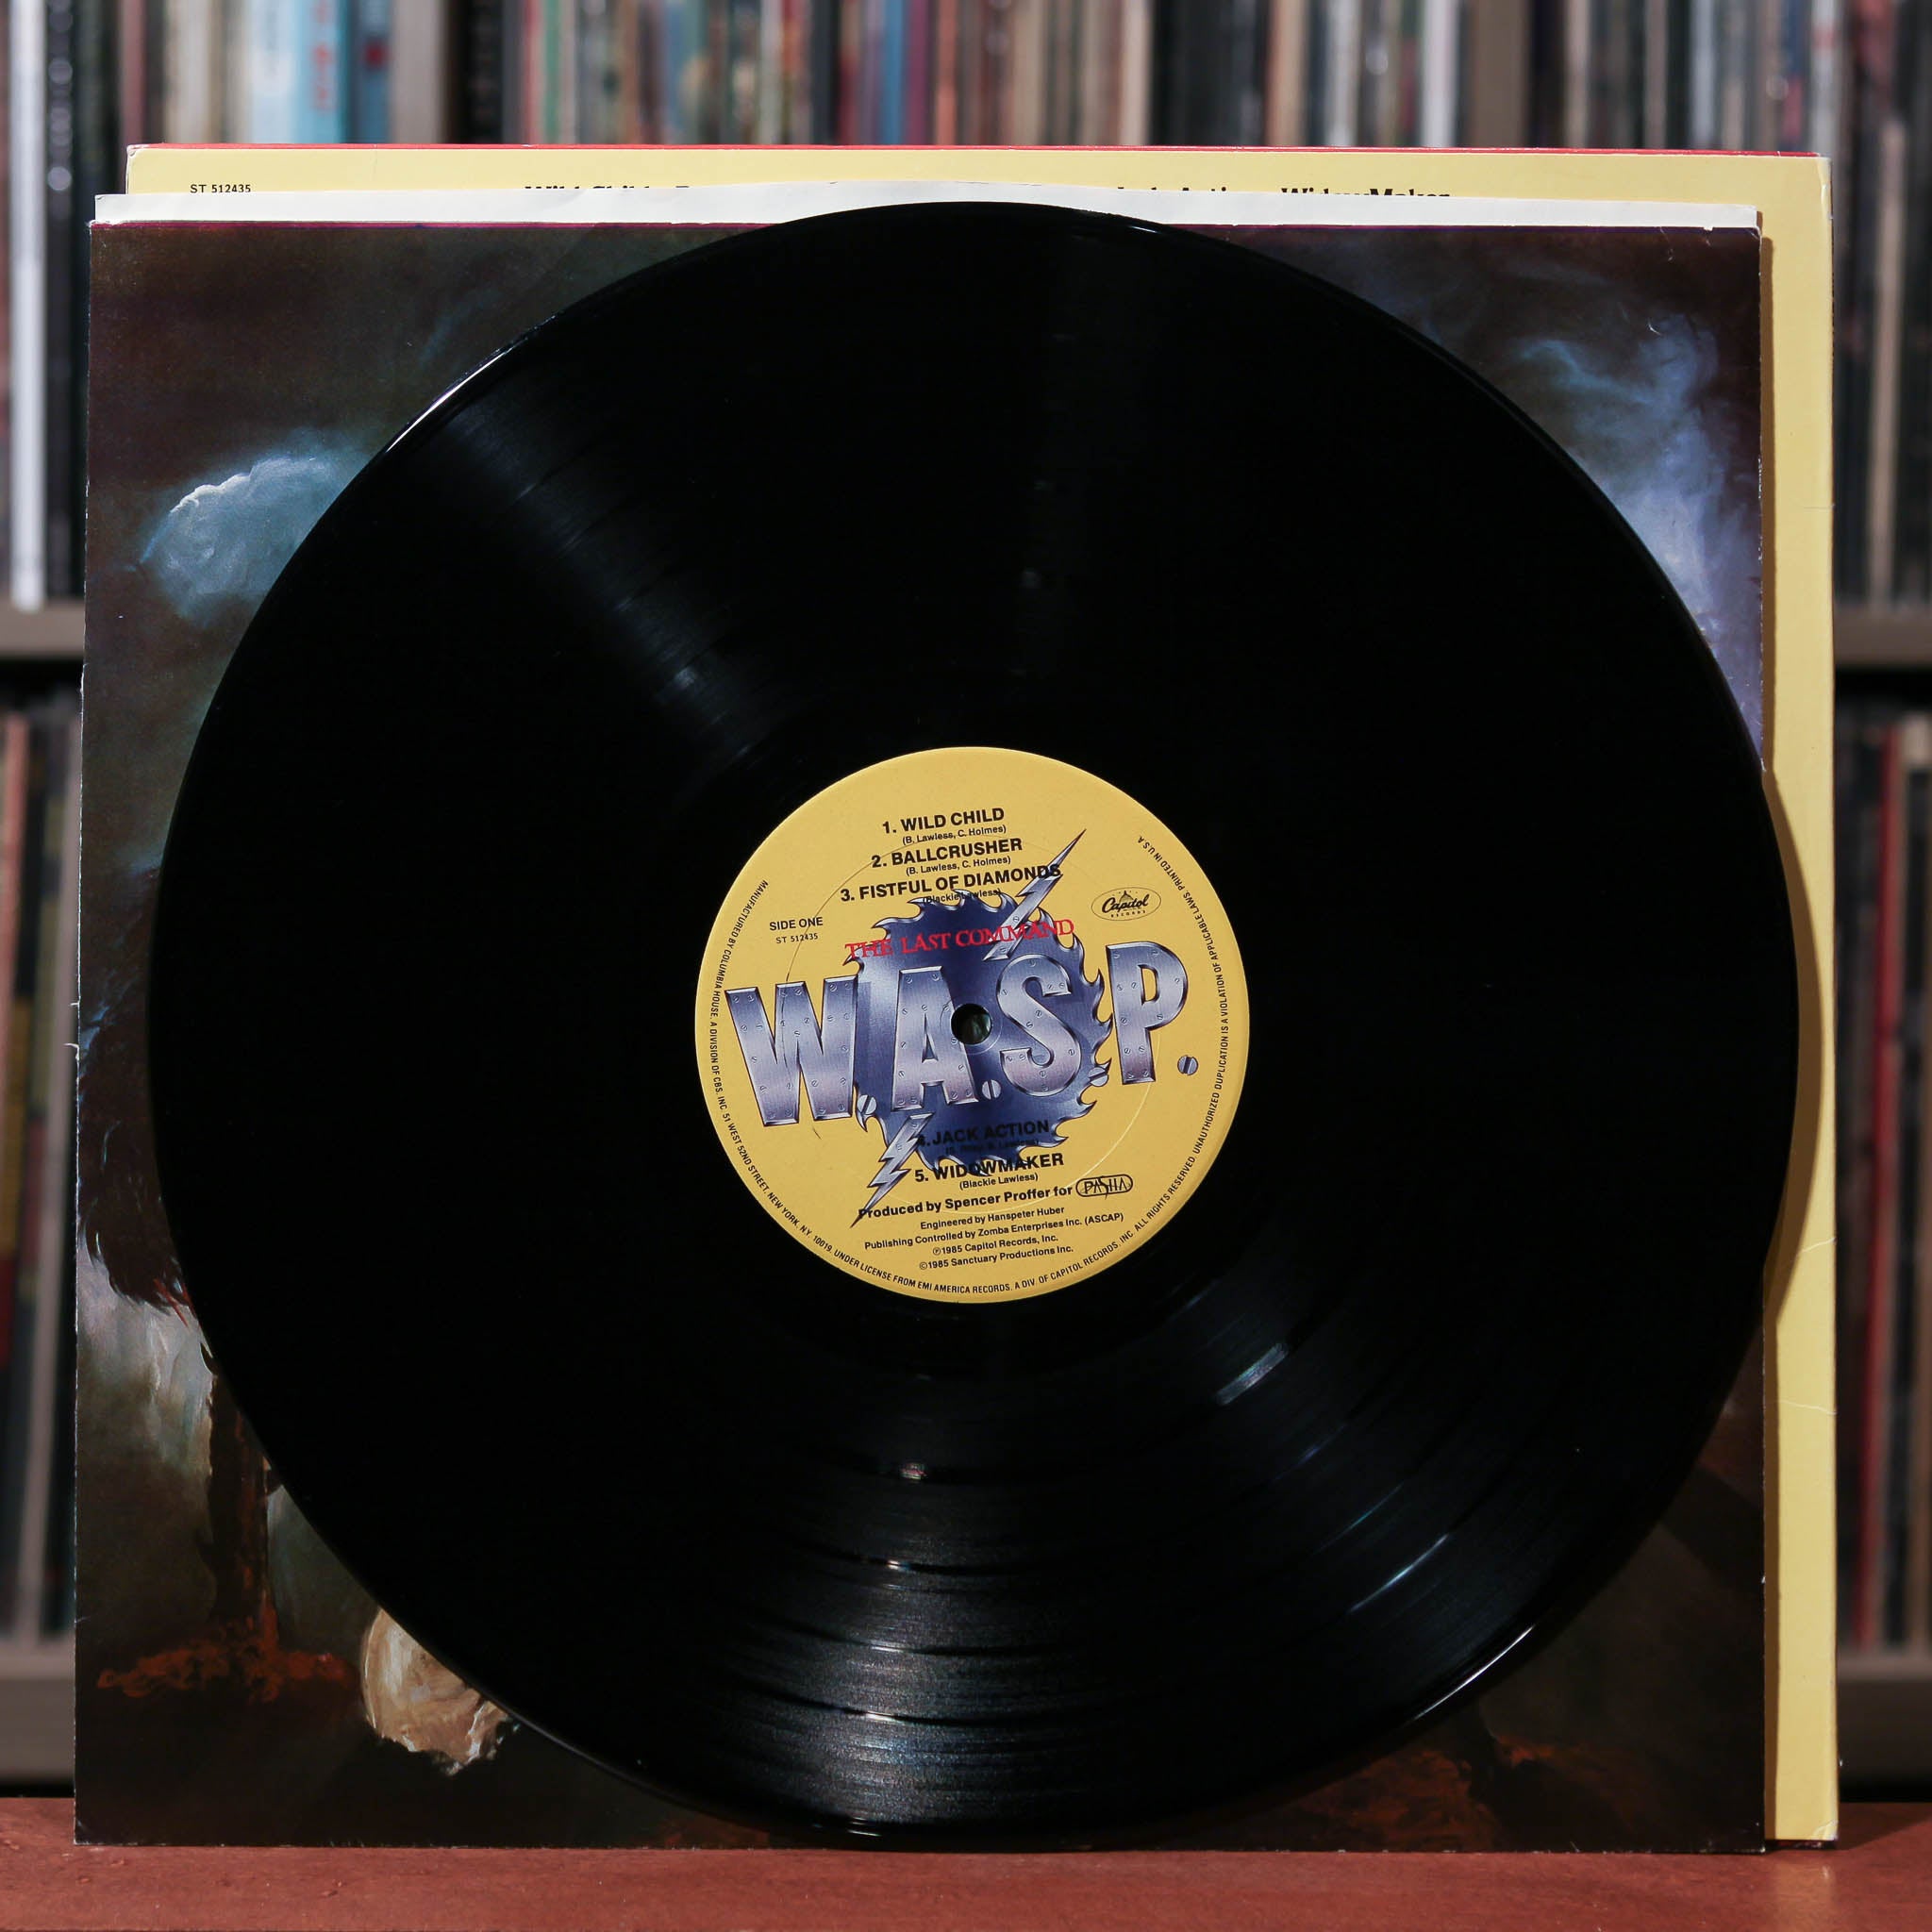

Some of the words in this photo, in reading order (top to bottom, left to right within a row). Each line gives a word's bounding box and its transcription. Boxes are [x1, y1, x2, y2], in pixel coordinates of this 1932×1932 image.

[191, 184, 207, 193] ST
[211, 184, 251, 193] 512435
[882, 821, 897, 834] 1.
[901, 814, 946, 831] WILD
[951, 808, 1005, 824] CHILD
[903, 836, 915, 846] (B.
[917, 829, 957, 842] Lawless,
[969, 824, 1007, 836] Holmes)
[872, 855, 887, 868] 2.
[891, 838, 1023, 865] BALLCRUSHER
[1154, 853, 1162, 862] IN
[906, 867, 919, 876] (B.
[921, 861, 960, 873] Lawless,
[961, 859, 971, 868] C.
[974, 856, 1011, 867] Holmes)
[1160, 860, 1185, 891] PRINTED
[841, 889, 855, 902] 3.
[859, 879, 931, 899] FISTFUL
[936, 875, 959, 892] OF
[964, 864, 1060, 887] DIAMONDS
[731, 880, 768, 937] MANUFACTURED
[1102, 894, 1150, 913] Capitol
[770, 920, 796, 931] SIDE
[799, 917, 824, 927] ONE
[726, 938, 736, 948] BY
[791, 933, 818, 941] 512435
[845, 940, 893, 958] THE
[901, 933, 951, 954] LAST
[956, 919, 1074, 946] COMMAND
[1194, 914, 1218, 959] APPLICABLE
[715, 949, 731, 989] COLUMBIA
[1212, 962, 1222, 973] OF
[1215, 974, 1228, 1016] VIOLATION
[709, 1029, 718, 1063] DIVISION
[711, 1065, 720, 1074] OF
[1214, 1036, 1228, 1090] DUPLICATION
[723, 1113, 731, 1122] 51
[1192, 1092, 1220, 1154] UNAUTHORIZED
[727, 1123, 741, 1144] WEST
[933, 1127, 978, 1144] JACK
[984, 1120, 1049, 1140] ACTION
[737, 1145, 752, 1165] 52ND
[915, 1170, 928, 1182] 5.
[933, 1153, 1064, 1180] WIDOWMAKER
[959, 1179, 996, 1191] (Blackie
[998, 1173, 1038, 1184] Lawless)
[767, 1192, 783, 1208] NEW
[858, 1202, 923, 1218] Produced
[926, 1201, 941, 1212] by
[945, 1194, 1000, 1210] Spencer
[1004, 1187, 1051, 1202] Proffer
[1054, 1186, 1073, 1196] for
[1146, 1193, 1170, 1219] RIGHTS
[921, 1216, 973, 1230] Engineered
[988, 1208, 1034, 1222] Hanspeter
[1037, 1207, 1064, 1216] Huber
[1134, 1218, 1148, 1231] ALL
[864, 1238, 913, 1249] Publishing
[915, 1230, 963, 1244] Controlled
[965, 1230, 975, 1239] by
[978, 1225, 1008, 1237] Zomba
[1011, 1221, 1063, 1233] Enterprises
[1066, 1218, 1082, 1226] Inc.
[1085, 1212, 1124, 1225] (ASCAP)
[965, 1241, 996, 1253] Capitol
[1041, 1234, 1058, 1242] Inc.
[834, 1249, 859, 1268] UNDER
[951, 1255, 997, 1267] Sanctuary
[1000, 1249, 1055, 1260] Productions
[1057, 1245, 1074, 1254] Inc.
[860, 1263, 891, 1281] LICENSE
[892, 1275, 916, 1287] FROM
[1039, 1274, 1048, 1283] OF
[1050, 1262, 1083, 1280] CAPITOL
[917, 1281, 932, 1291] EMI
[934, 1284, 970, 1293] AMERICA
